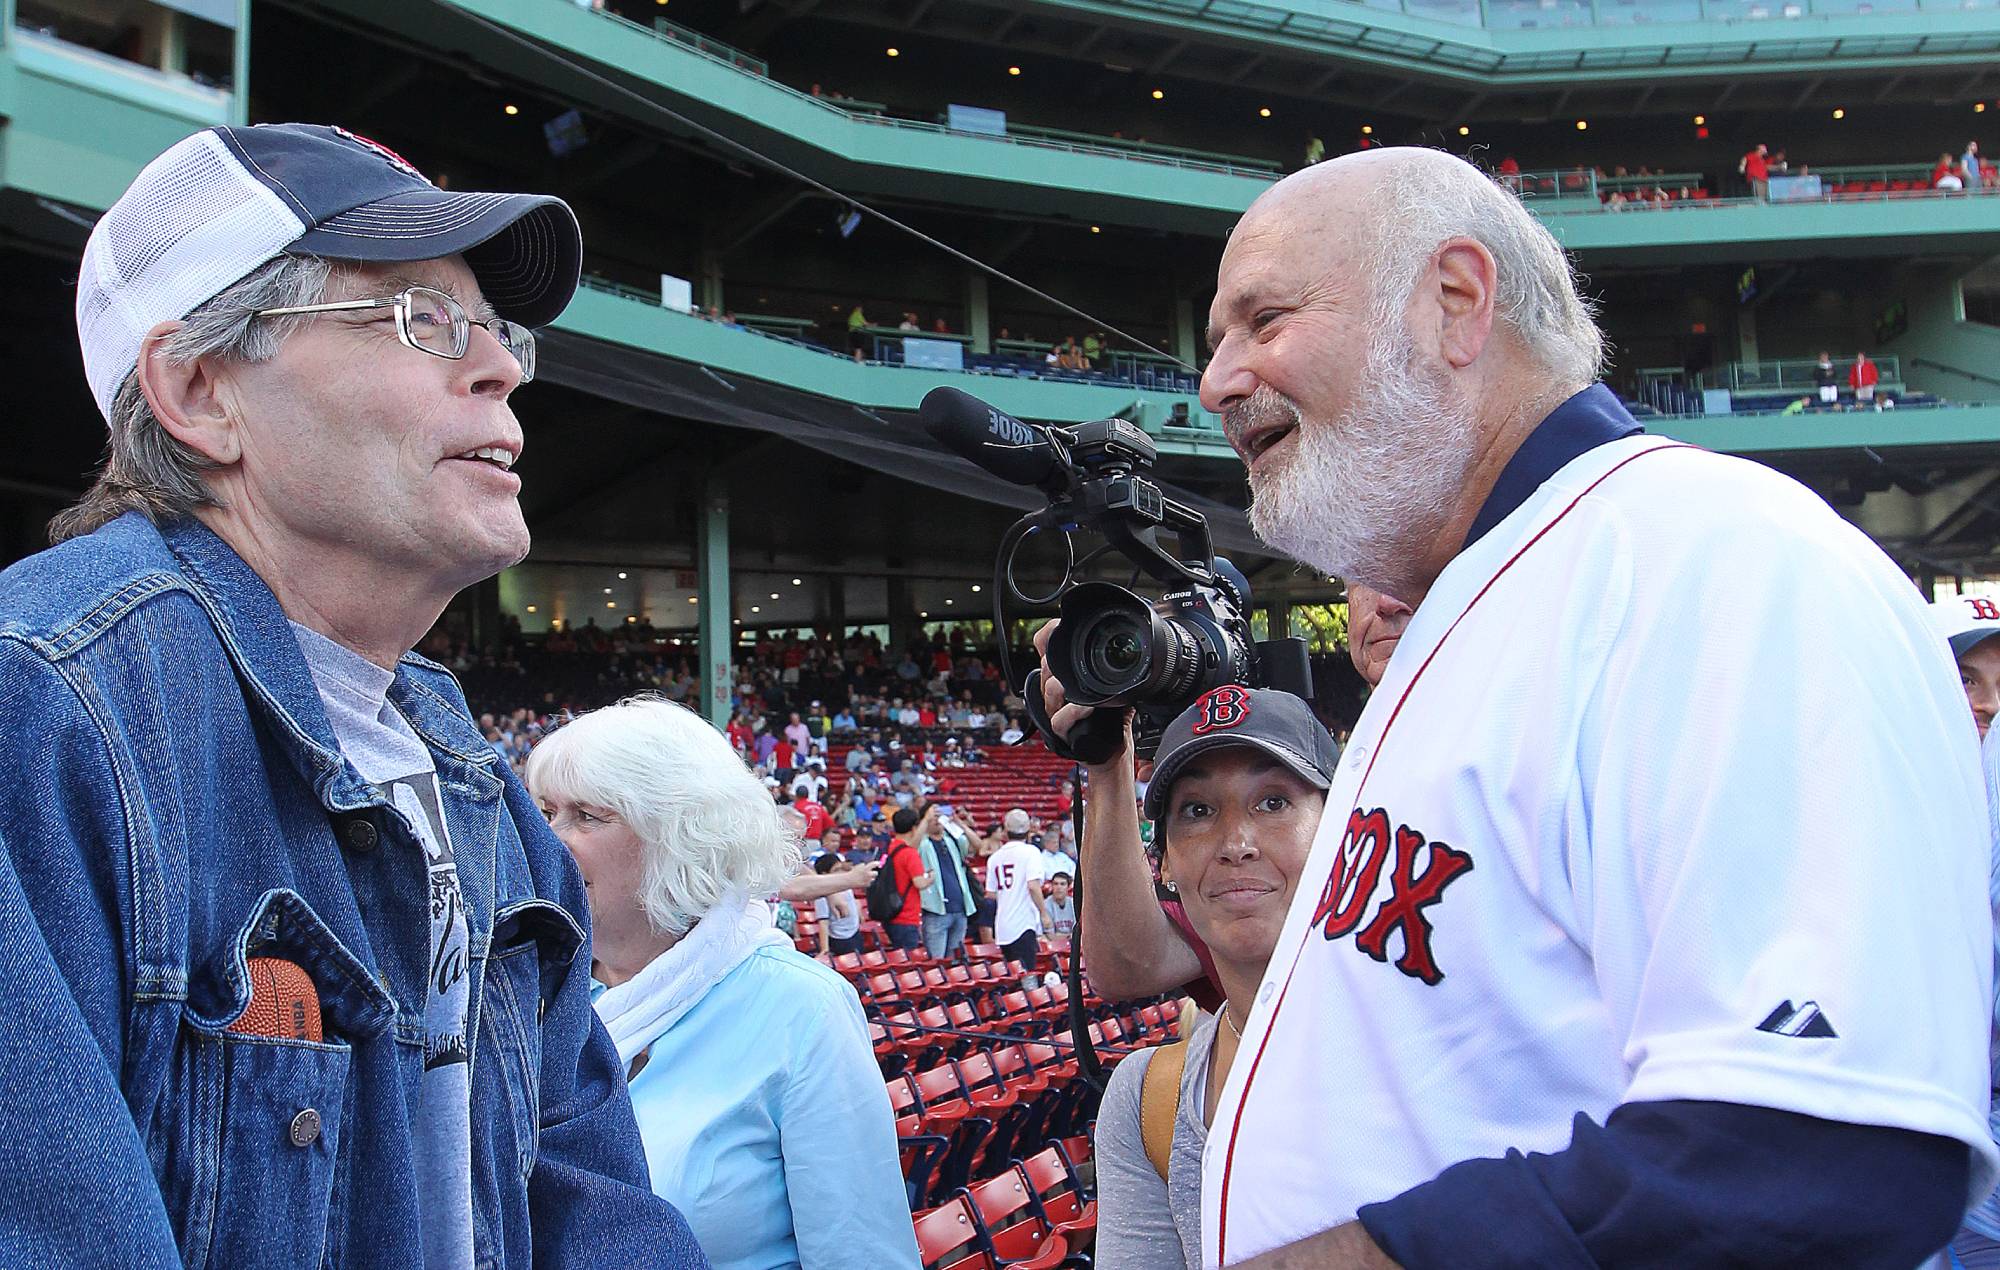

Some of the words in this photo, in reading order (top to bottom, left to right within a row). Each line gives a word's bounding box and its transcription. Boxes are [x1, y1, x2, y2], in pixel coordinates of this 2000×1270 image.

[1163, 591, 1192, 601] Canon
[1964, 599, 2000, 620] B
[1192, 684, 1250, 735] B
[995, 864, 1015, 890] 15
[293, 1001, 305, 1030] NBA
